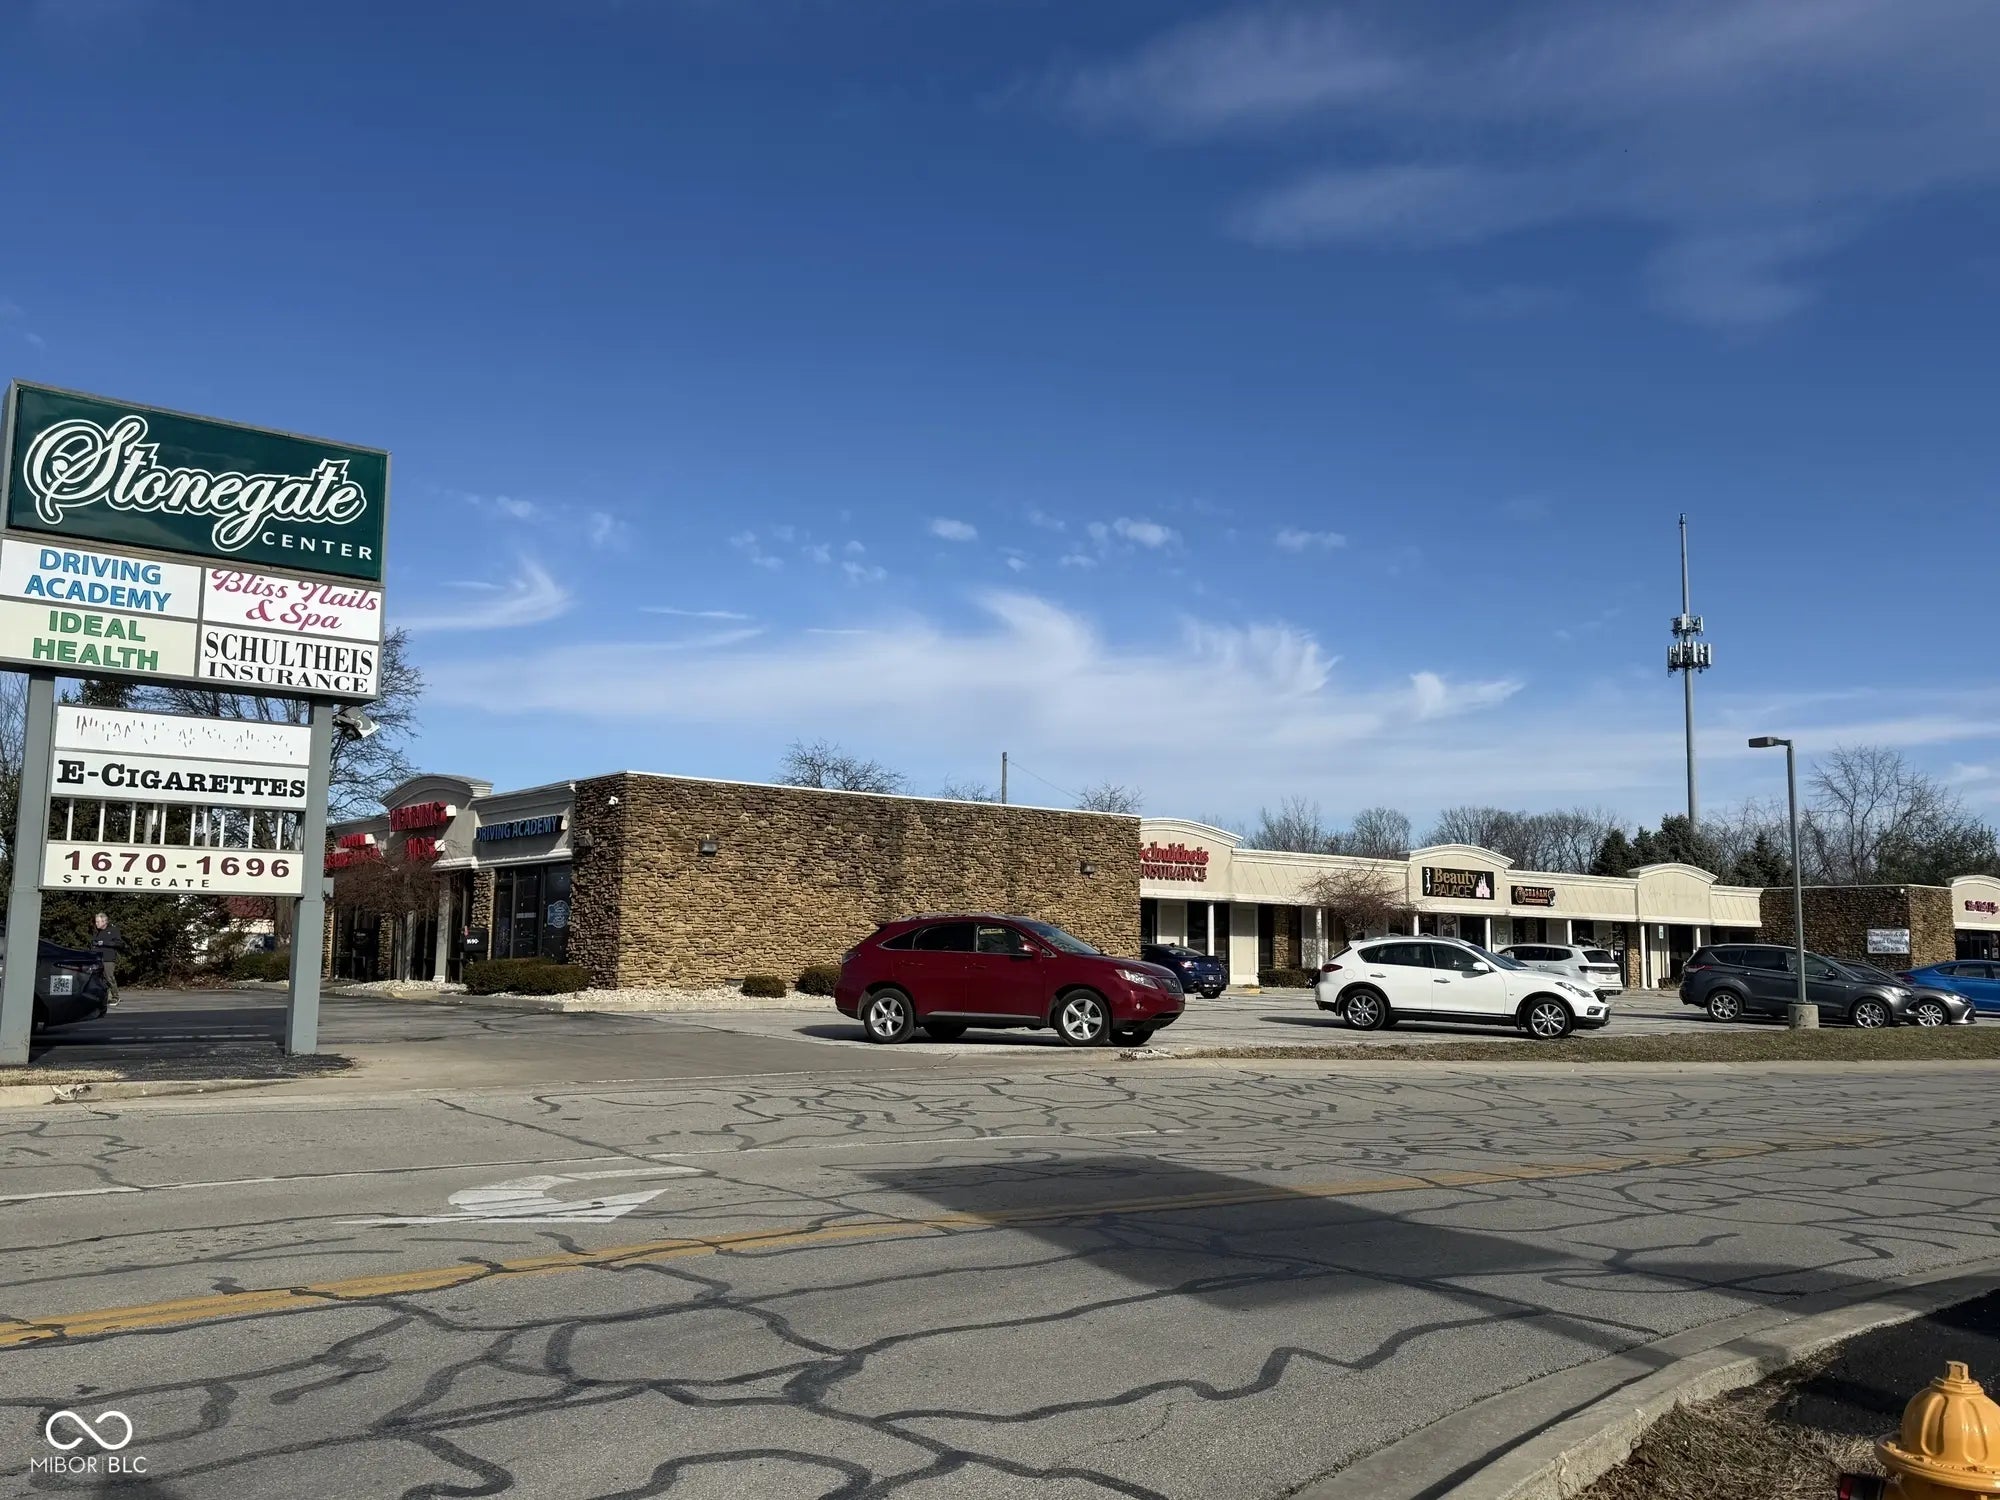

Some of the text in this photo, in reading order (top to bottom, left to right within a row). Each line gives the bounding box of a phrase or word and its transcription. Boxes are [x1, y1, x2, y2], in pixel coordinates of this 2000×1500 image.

[24, 414, 367, 551] Stonegate
[261, 531, 373, 561] CENTER
[39, 548, 162, 586] DRIVING
[24, 574, 172, 613] ACADEMY
[211, 567, 378, 611] Bliss Nails
[49, 610, 147, 643] IDEAL
[245, 599, 343, 631] & Spa
[33, 637, 159, 671] HEALTH
[204, 631, 374, 676] SCHULTHEIS
[208, 661, 369, 693] INSURANCE
[56, 759, 306, 799] E-CIGARETTES
[476, 815, 558, 843] DRIVING ACADEMY
[64, 850, 290, 878] 1670-1696
[1433, 867, 1477, 889] Beauty
[62, 874, 211, 889] STONEGATE
[1433, 883, 1471, 898] PALACE
